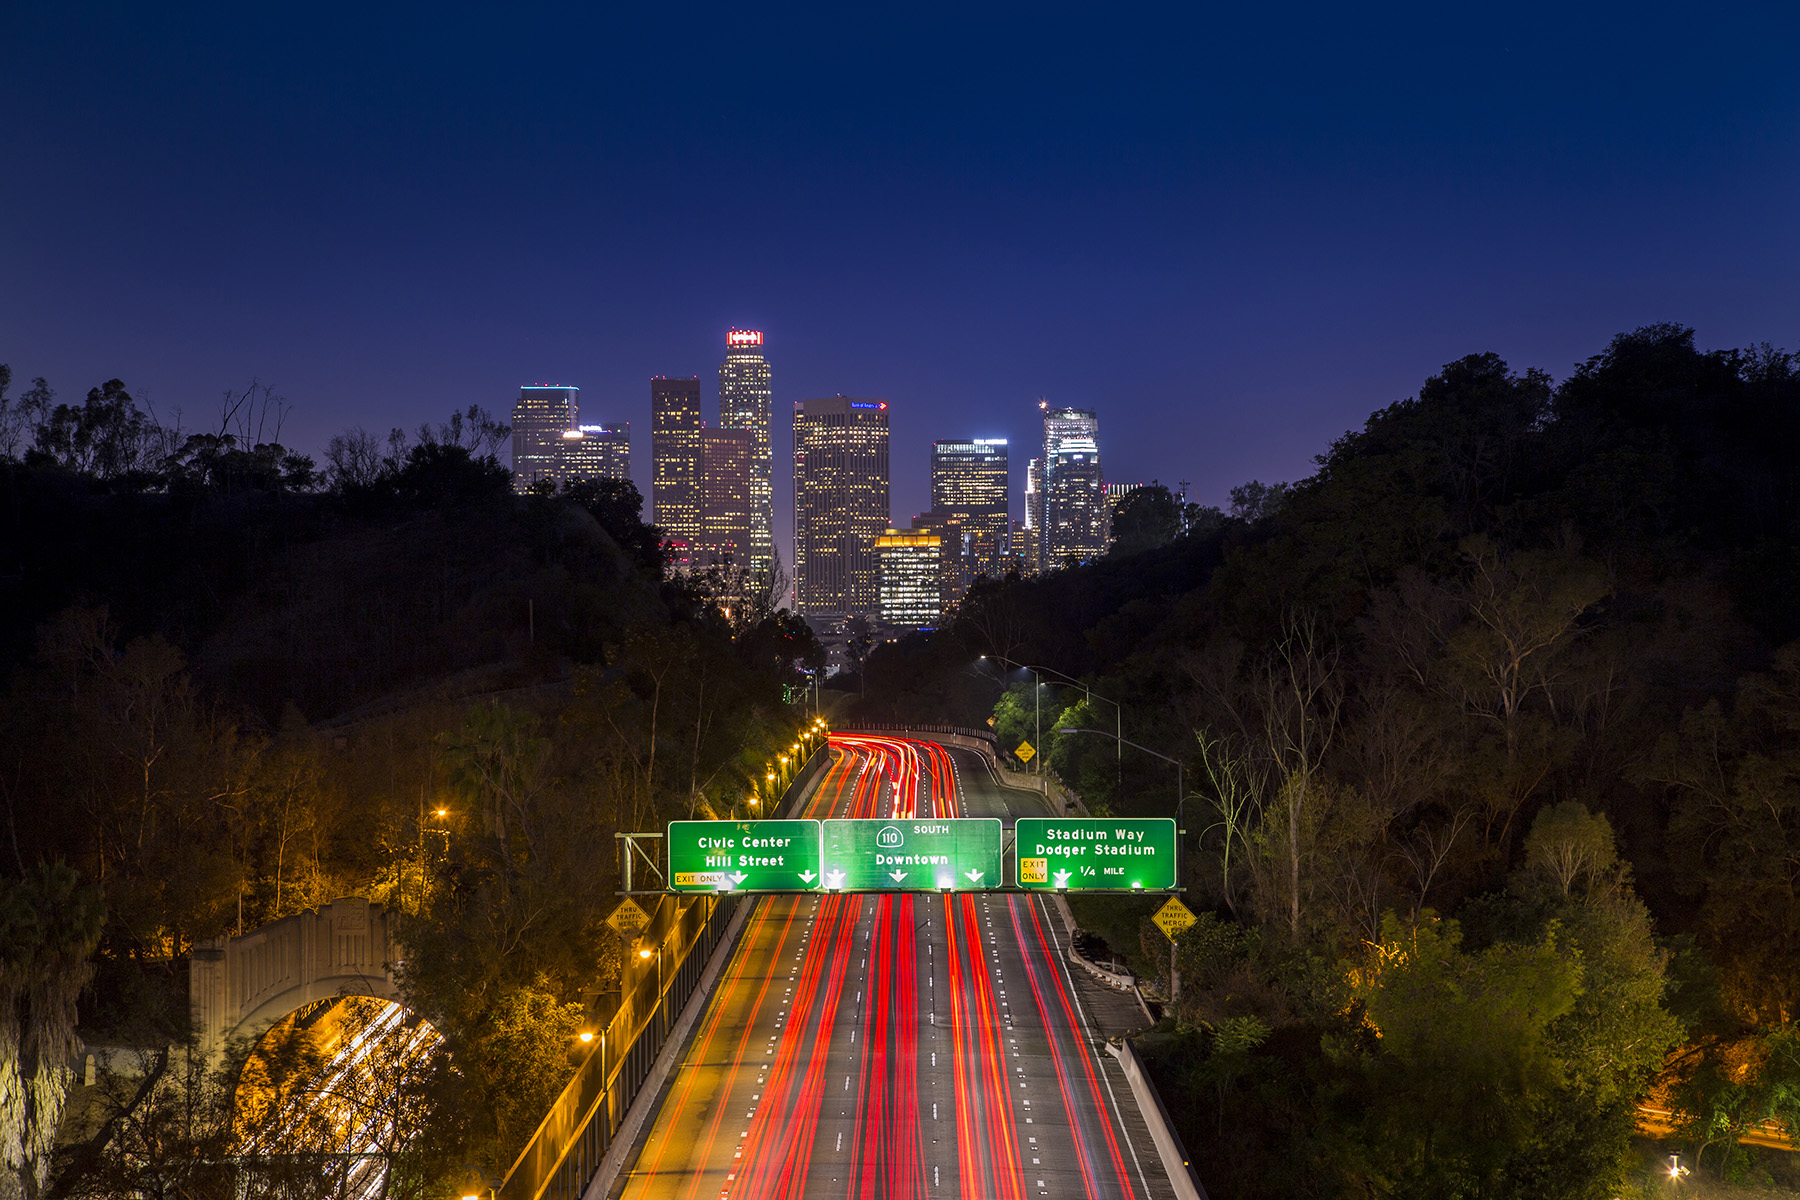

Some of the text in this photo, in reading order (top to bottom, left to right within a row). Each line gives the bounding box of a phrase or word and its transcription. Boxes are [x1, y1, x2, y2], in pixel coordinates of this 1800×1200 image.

[913, 825, 949, 834] SOUTH
[882, 832, 898, 843] 110
[1046, 828, 1145, 843] Stadium Way
[698, 836, 791, 849] Civic Center
[1036, 844, 1155, 858] Dodger Stadium
[705, 855, 784, 867] Hill Street
[876, 854, 949, 865] Downtown
[1022, 860, 1045, 868] EXIT
[1022, 872, 1046, 880] ONLY
[1103, 867, 1125, 875] MILE
[676, 875, 723, 883] EXIT ONLY
